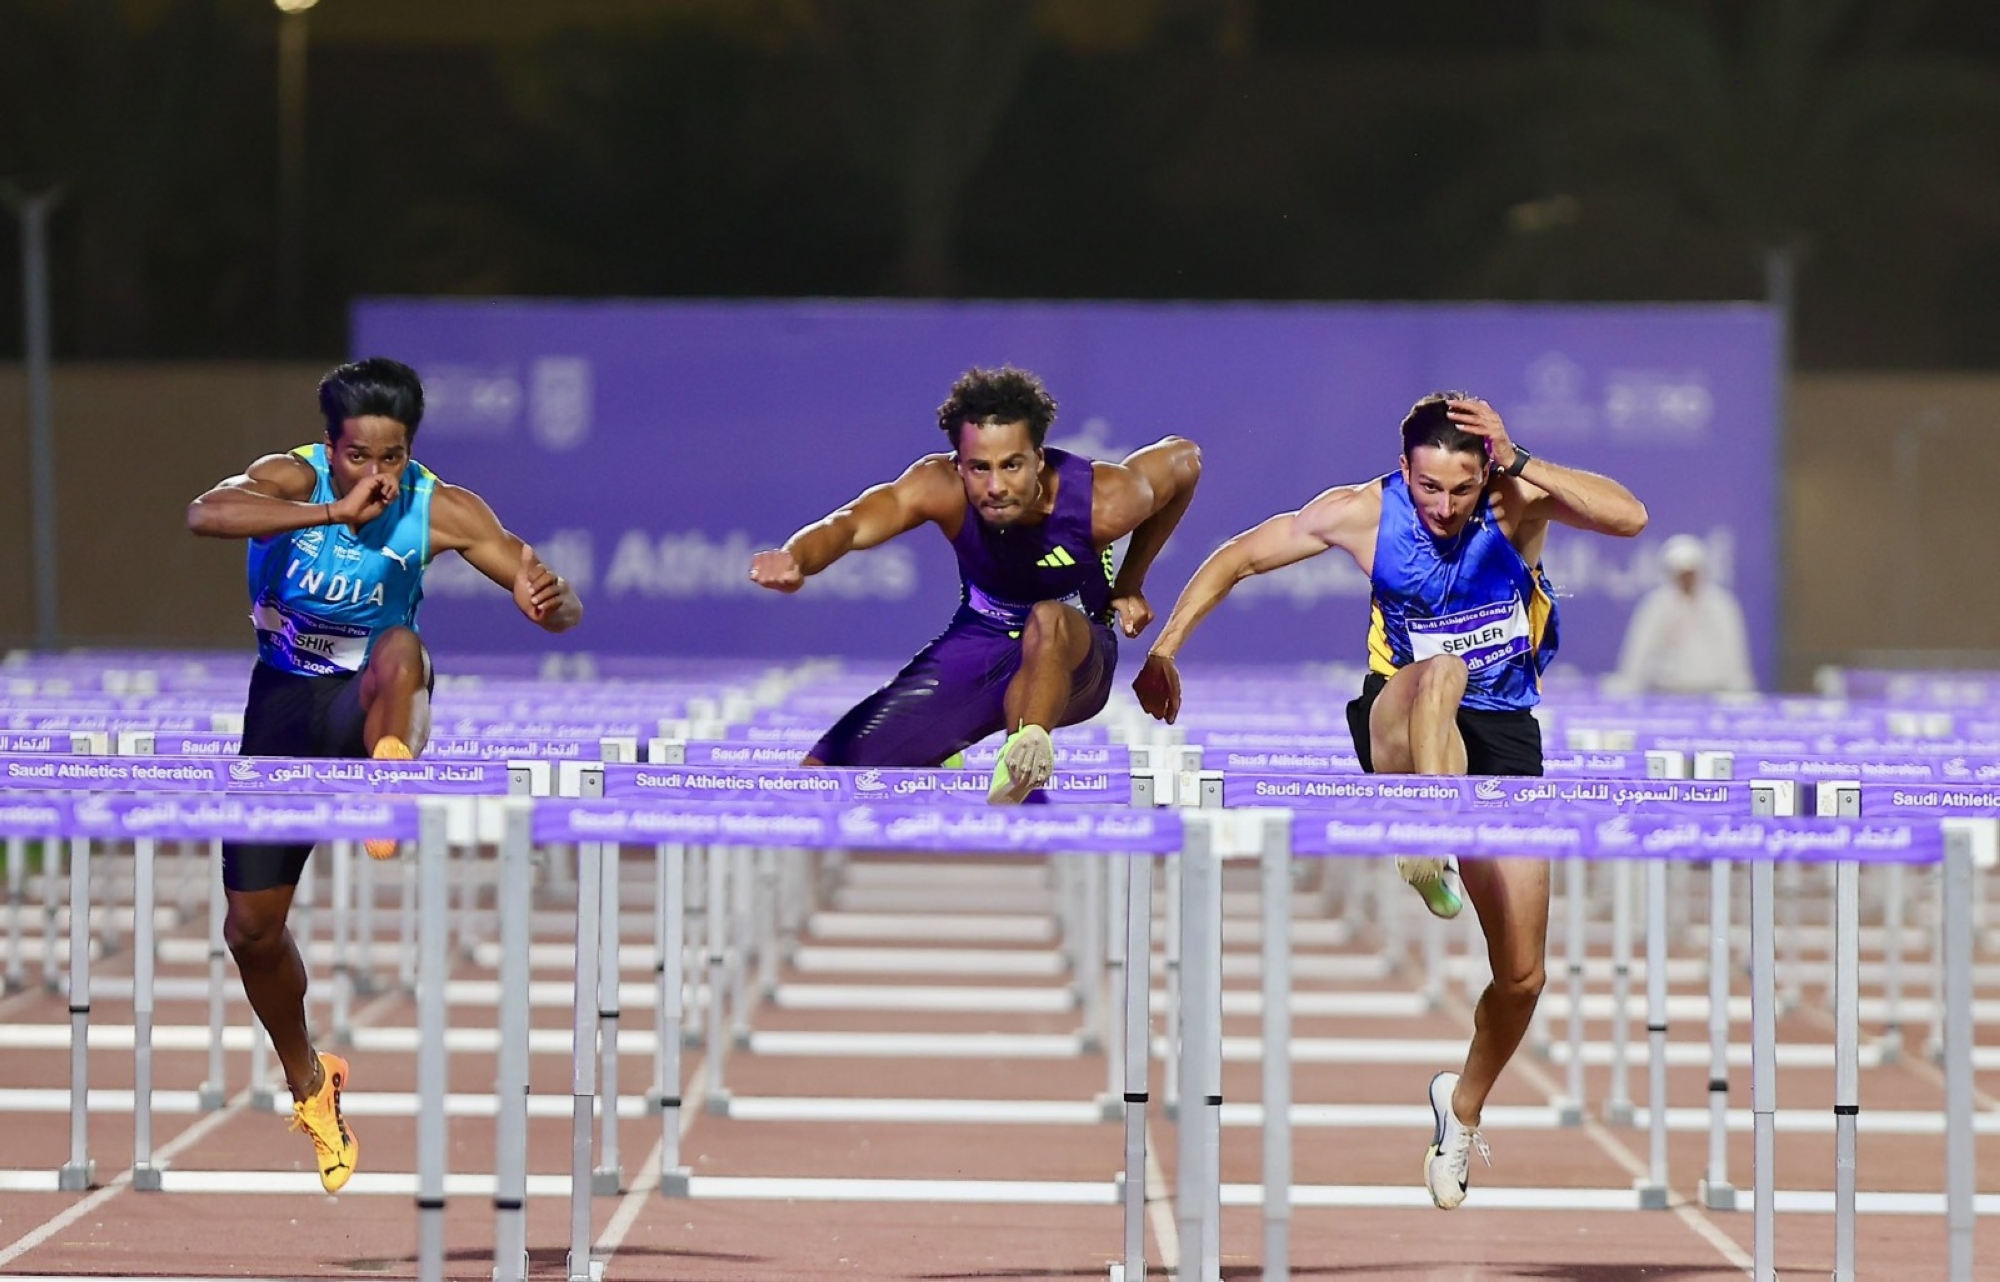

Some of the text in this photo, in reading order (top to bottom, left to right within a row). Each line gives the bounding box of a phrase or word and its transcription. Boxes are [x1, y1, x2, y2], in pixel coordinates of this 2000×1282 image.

[286, 558, 384, 606] INDIA
[1439, 613, 1478, 627] Athletics
[1479, 606, 1507, 619] Grand
[1443, 628, 1504, 653] SEVLER
[1485, 644, 1514, 665] 2026
[303, 660, 335, 675] 2026
[182, 740, 220, 754] Saudi
[711, 747, 749, 760] Saudi
[1228, 753, 1266, 766] Saudi
[1269, 754, 1329, 768] Athletics
[8, 763, 214, 780] Saudi Athletics federation
[268, 763, 484, 786] الاتحاد السعودي لألعاب القوى
[636, 773, 839, 791] Saudi Athletics federation
[893, 775, 936, 794] القوى
[1062, 775, 1108, 791] الاتحاد
[1256, 781, 1459, 799] Saudi Athletics federation
[1513, 783, 1728, 806] الاتحاد السعودي لألعاب القوى
[1893, 791, 2000, 808] Saudi Athletic
